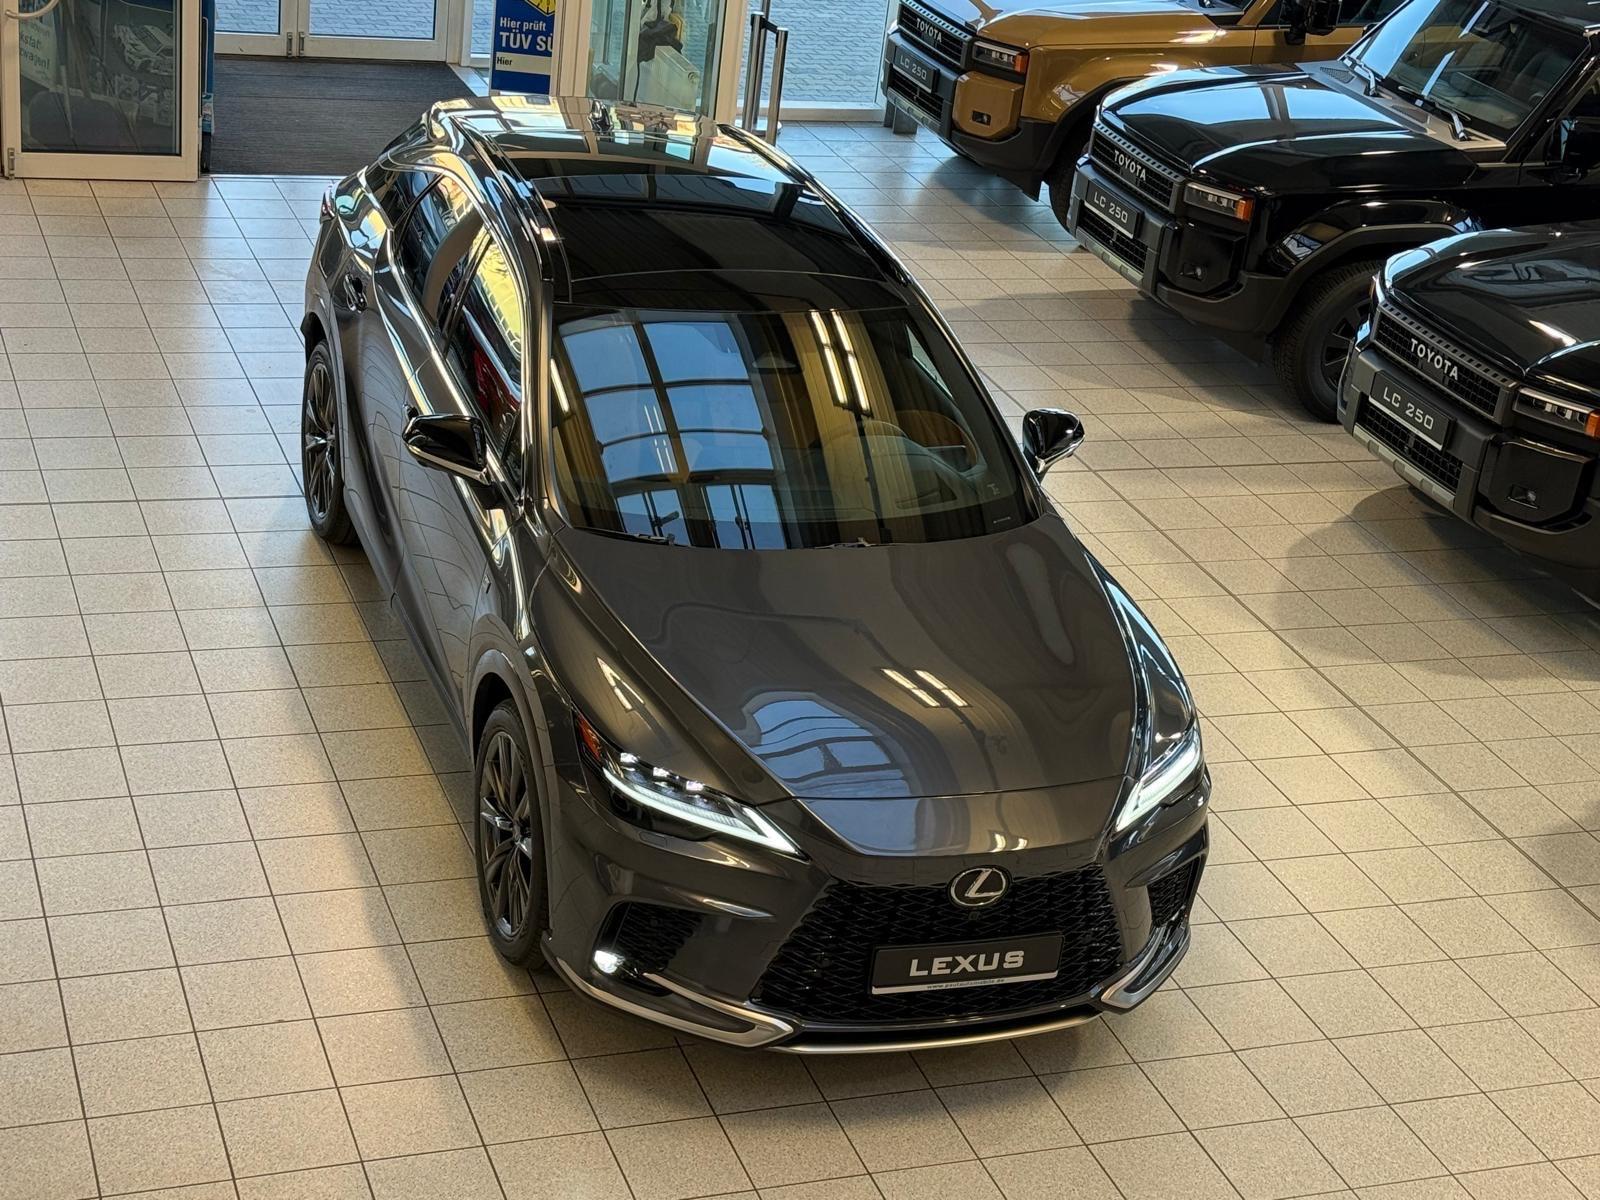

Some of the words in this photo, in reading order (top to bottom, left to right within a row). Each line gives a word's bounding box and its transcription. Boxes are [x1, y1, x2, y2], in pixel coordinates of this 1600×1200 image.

[500, 17, 521, 29] Hier
[523, 20, 546, 32] prüft
[916, 18, 942, 42] TOYOTA
[500, 29, 532, 49] TÜV
[496, 56, 512, 66] Hier
[900, 55, 911, 68] LC
[912, 63, 927, 80] 250
[1114, 150, 1146, 181] TOYOTA
[1094, 192, 1106, 208] LC
[1108, 202, 1128, 224] 250
[1410, 338, 1458, 380] TOYOTA
[1383, 387, 1401, 408] LC
[1405, 402, 1434, 430] 250
[909, 950, 1025, 977] LEXUS
